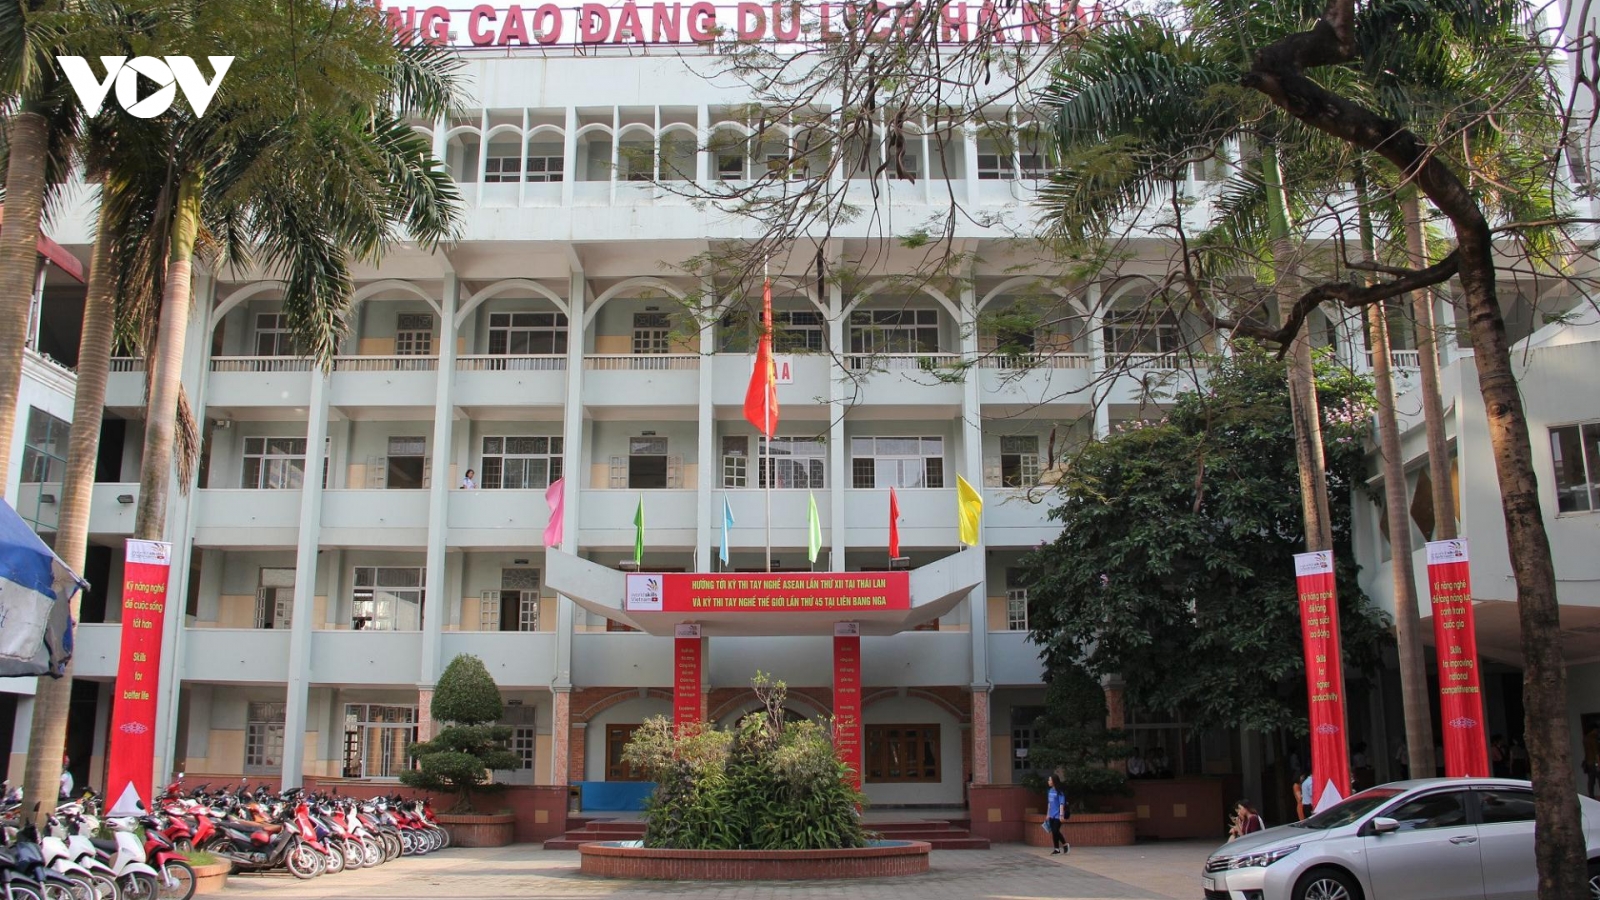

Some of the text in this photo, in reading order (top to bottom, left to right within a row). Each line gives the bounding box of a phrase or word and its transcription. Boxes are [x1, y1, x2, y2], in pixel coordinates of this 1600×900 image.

[468, 4, 564, 46] CAO
[738, 2, 800, 43] DU
[738, 580, 748, 590] THI
[750, 580, 761, 590] TAY
[783, 580, 804, 589] ASEAN
[835, 580, 844, 589] XII
[845, 579, 855, 590] TẠI
[857, 578, 872, 589] THÁI
[873, 579, 886, 588] LAN
[692, 596, 701, 607] VÀ
[712, 598, 723, 607] THI
[724, 598, 737, 607] TAY
[815, 597, 823, 606] 45
[852, 597, 870, 606] BANG
[872, 596, 886, 606] NGA
[133, 652, 146, 662] Skills
[135, 671, 143, 681] for
[124, 690, 140, 700] better
